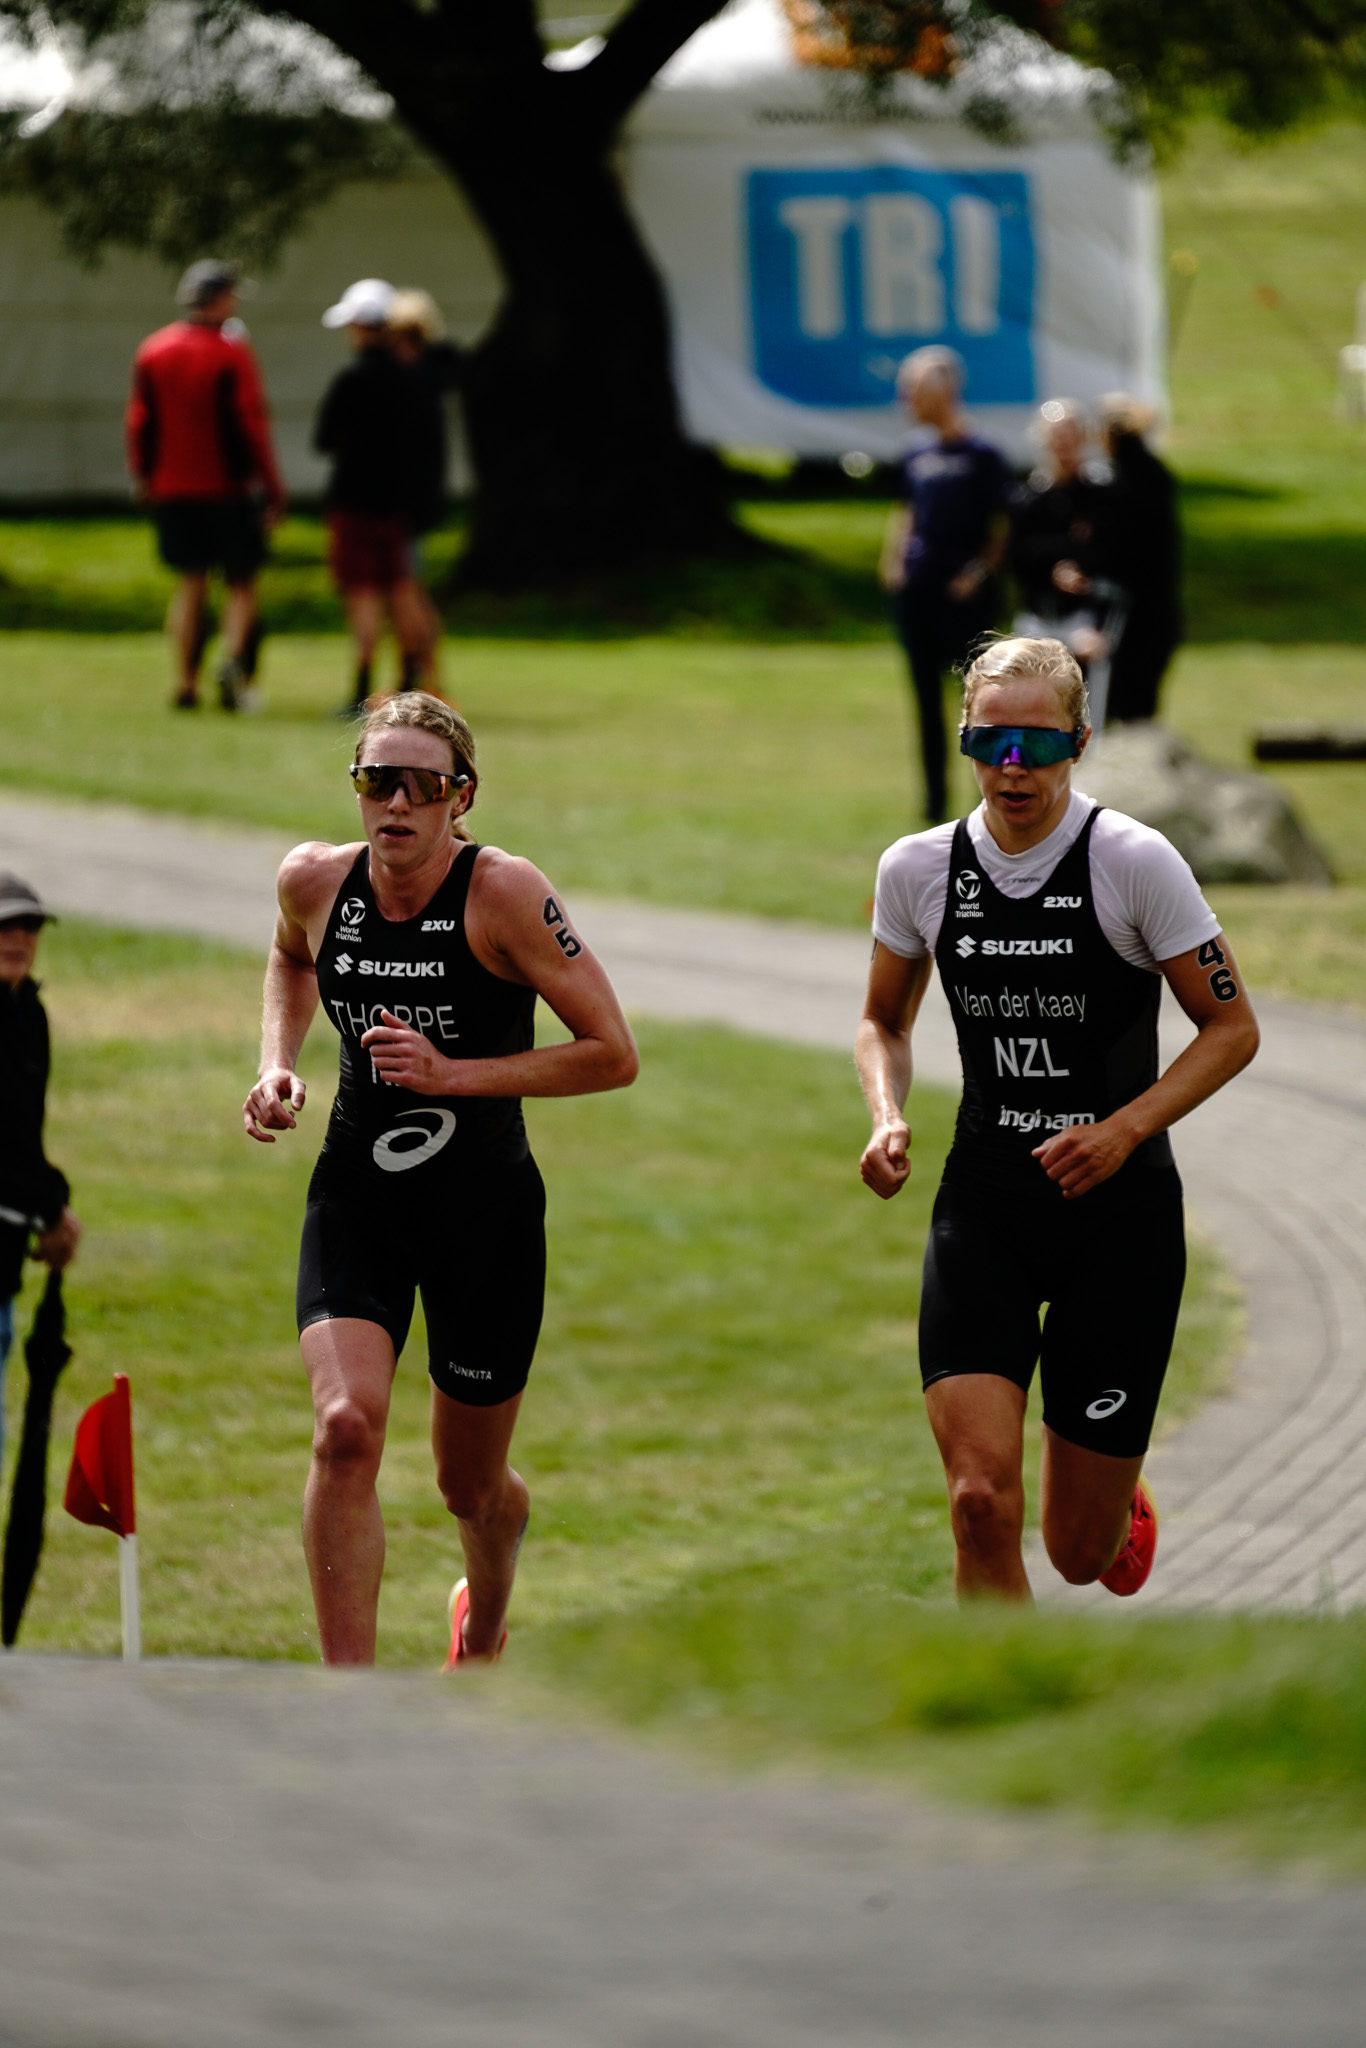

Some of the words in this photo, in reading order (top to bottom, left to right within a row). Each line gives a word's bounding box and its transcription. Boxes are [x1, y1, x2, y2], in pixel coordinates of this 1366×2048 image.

[780, 193, 999, 339] TRI
[958, 902, 980, 910] World
[1042, 896, 1083, 909] 2XU
[955, 910, 984, 918] Triathlon
[339, 924, 360, 935] World
[421, 919, 455, 932] 2XU
[981, 938, 1074, 956] SUZUKI
[357, 959, 445, 977] SUZUKI
[954, 985, 995, 1018] Van
[1000, 987, 1030, 1018] der
[1036, 989, 1087, 1023] kaay
[994, 1036, 1071, 1078] NZL
[998, 1105, 1095, 1133] ingham
[448, 1361, 493, 1381] FUNKITA
